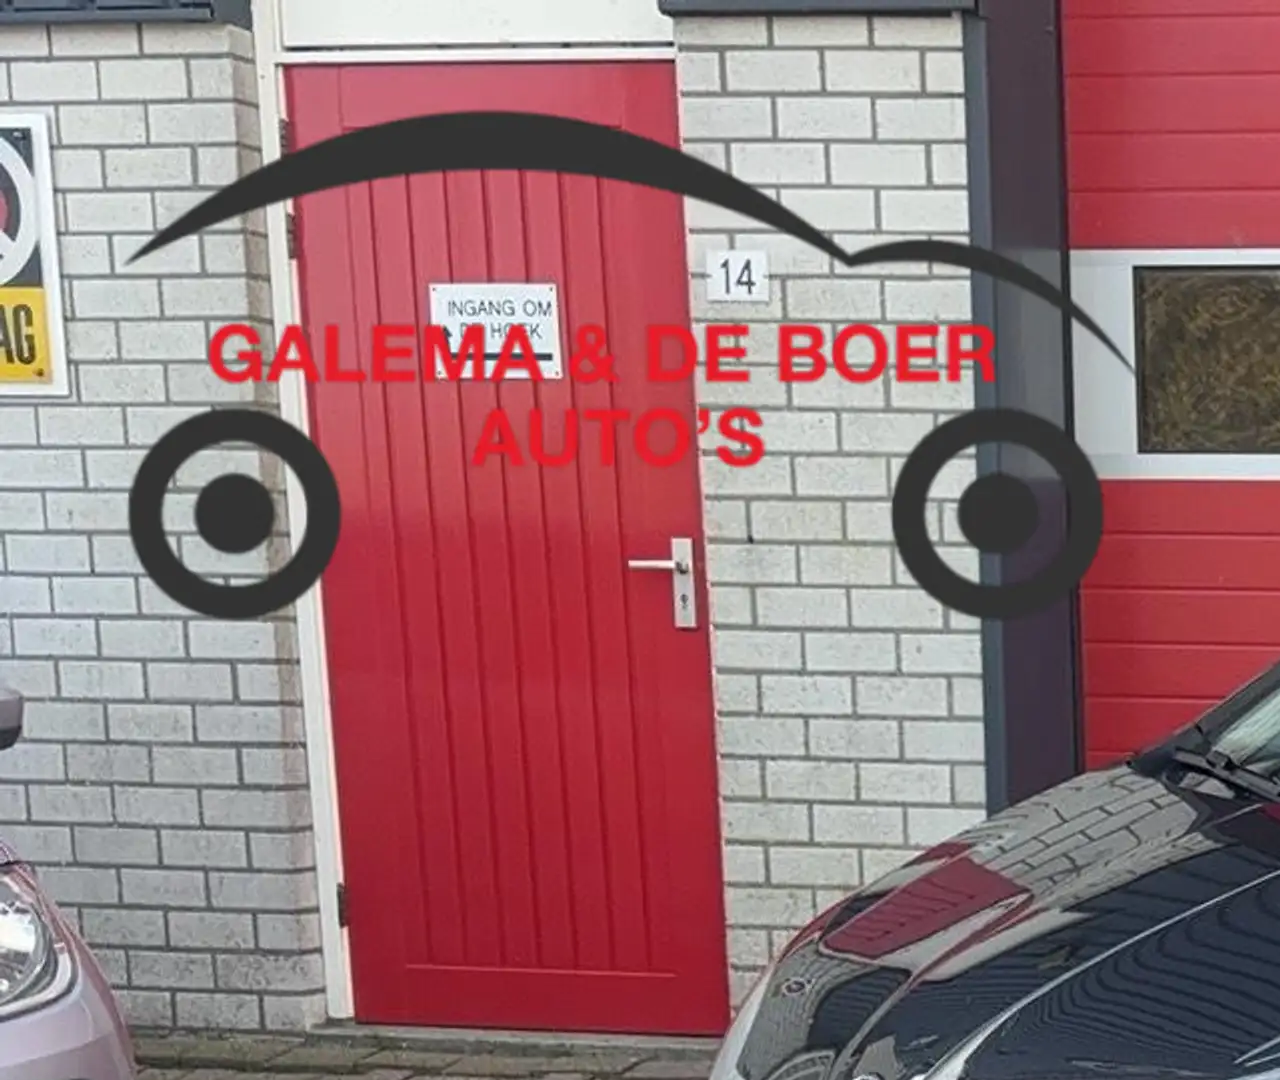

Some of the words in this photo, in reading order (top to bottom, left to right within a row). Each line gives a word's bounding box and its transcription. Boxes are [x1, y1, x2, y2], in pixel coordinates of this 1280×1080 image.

[720, 258, 756, 295] 14
[447, 299, 516, 317] INGANG
[522, 299, 552, 317] OM
[490, 322, 542, 340] HK
